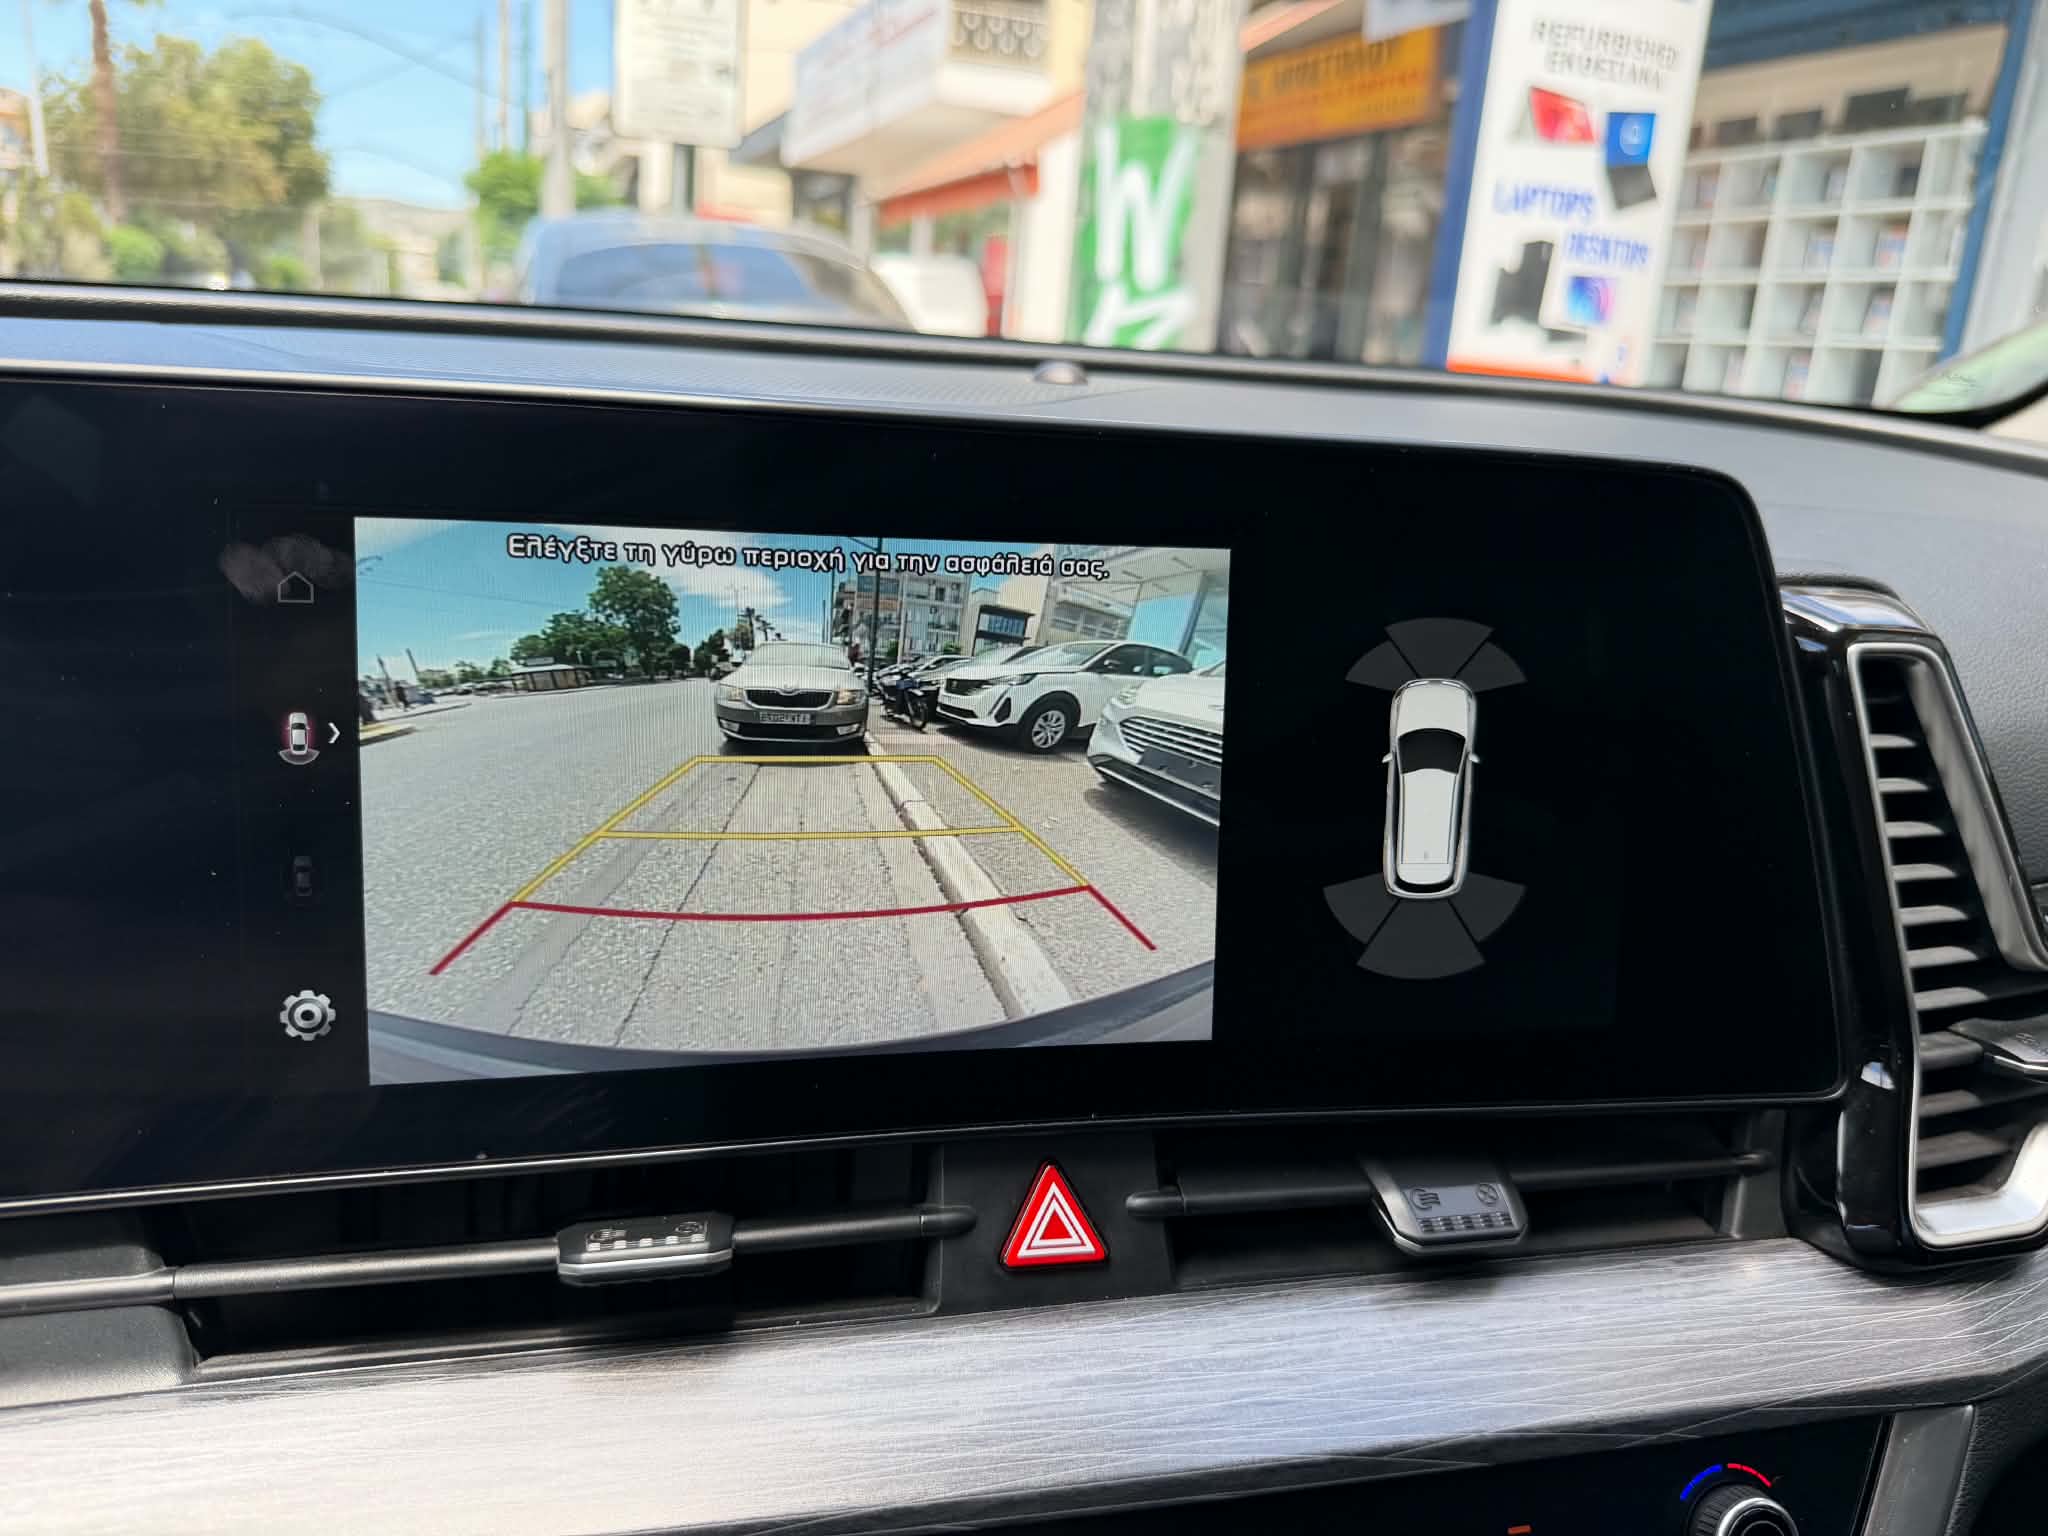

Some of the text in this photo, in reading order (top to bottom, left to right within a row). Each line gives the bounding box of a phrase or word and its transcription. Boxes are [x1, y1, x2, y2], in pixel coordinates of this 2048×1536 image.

[1532, 19, 1682, 69] REFURBISHED
[1493, 182, 1596, 221] LAPTOPS
[1566, 232, 1650, 269] DESKTOPS
[507, 533, 1110, 581] Ελέγξτε τη γύρω περιοχή για την ασφάλειά σας.
